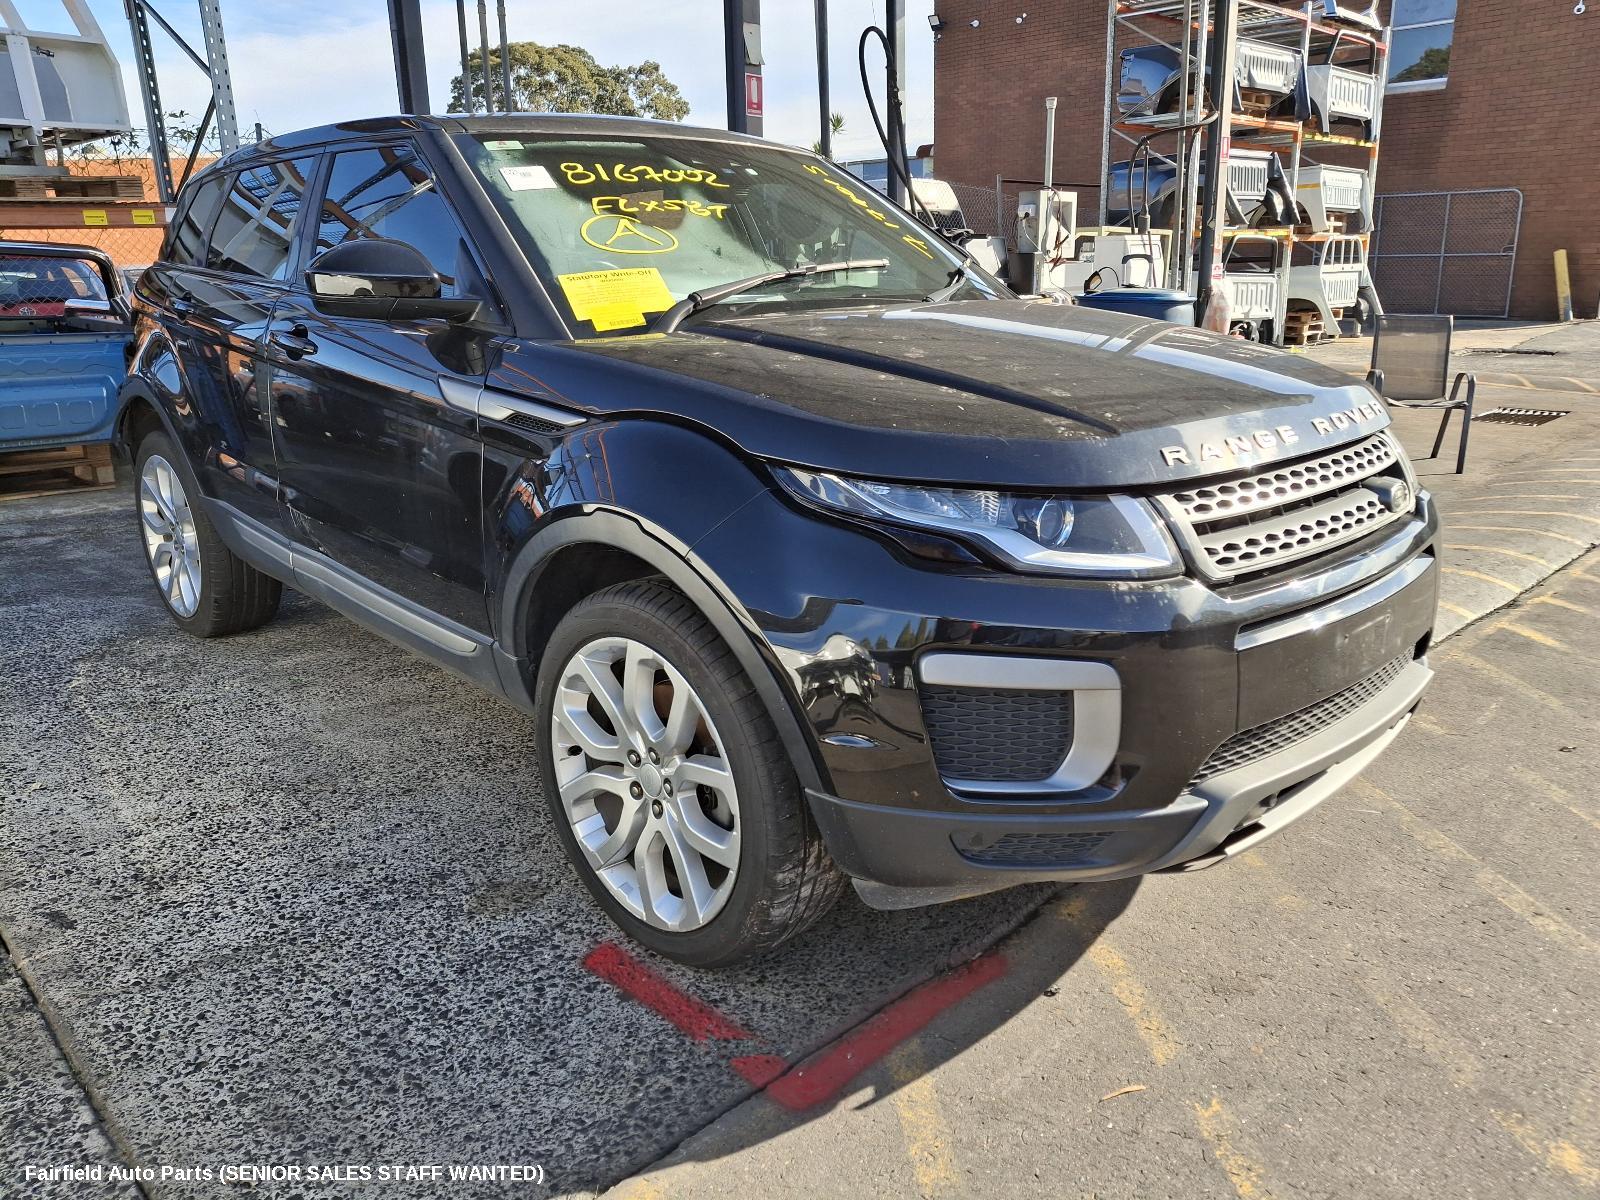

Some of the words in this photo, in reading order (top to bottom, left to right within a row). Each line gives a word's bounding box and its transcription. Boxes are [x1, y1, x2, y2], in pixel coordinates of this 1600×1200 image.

[566, 273, 608, 281] Statutory
[1160, 425, 1299, 466] RANGE
[1311, 400, 1384, 436] ROVER
